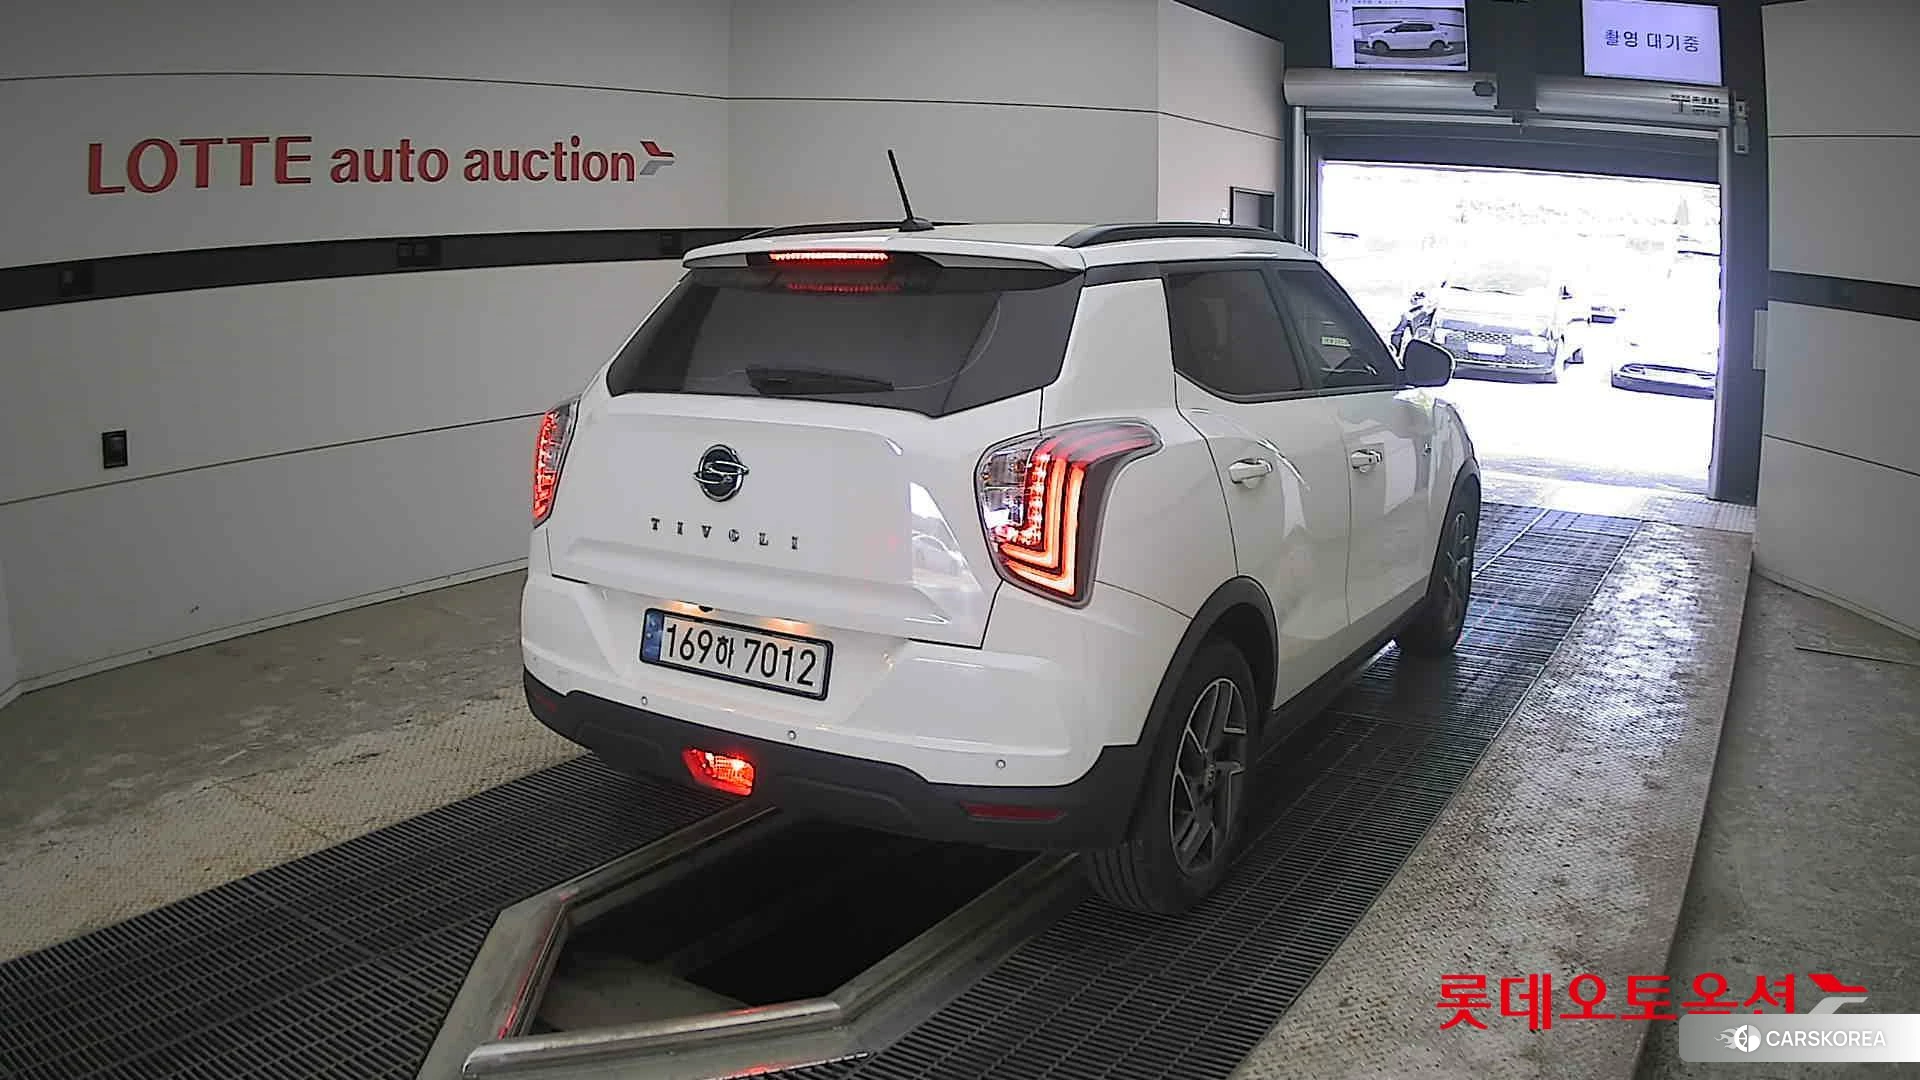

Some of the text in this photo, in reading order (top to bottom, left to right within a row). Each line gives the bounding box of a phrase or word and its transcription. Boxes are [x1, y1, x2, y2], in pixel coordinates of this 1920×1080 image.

[1647, 32, 1700, 52] 대기중
[88, 135, 636, 195] LOTTE auto auction
[651, 517, 799, 550] TIVOLI
[667, 623, 817, 686] 169하 7012
